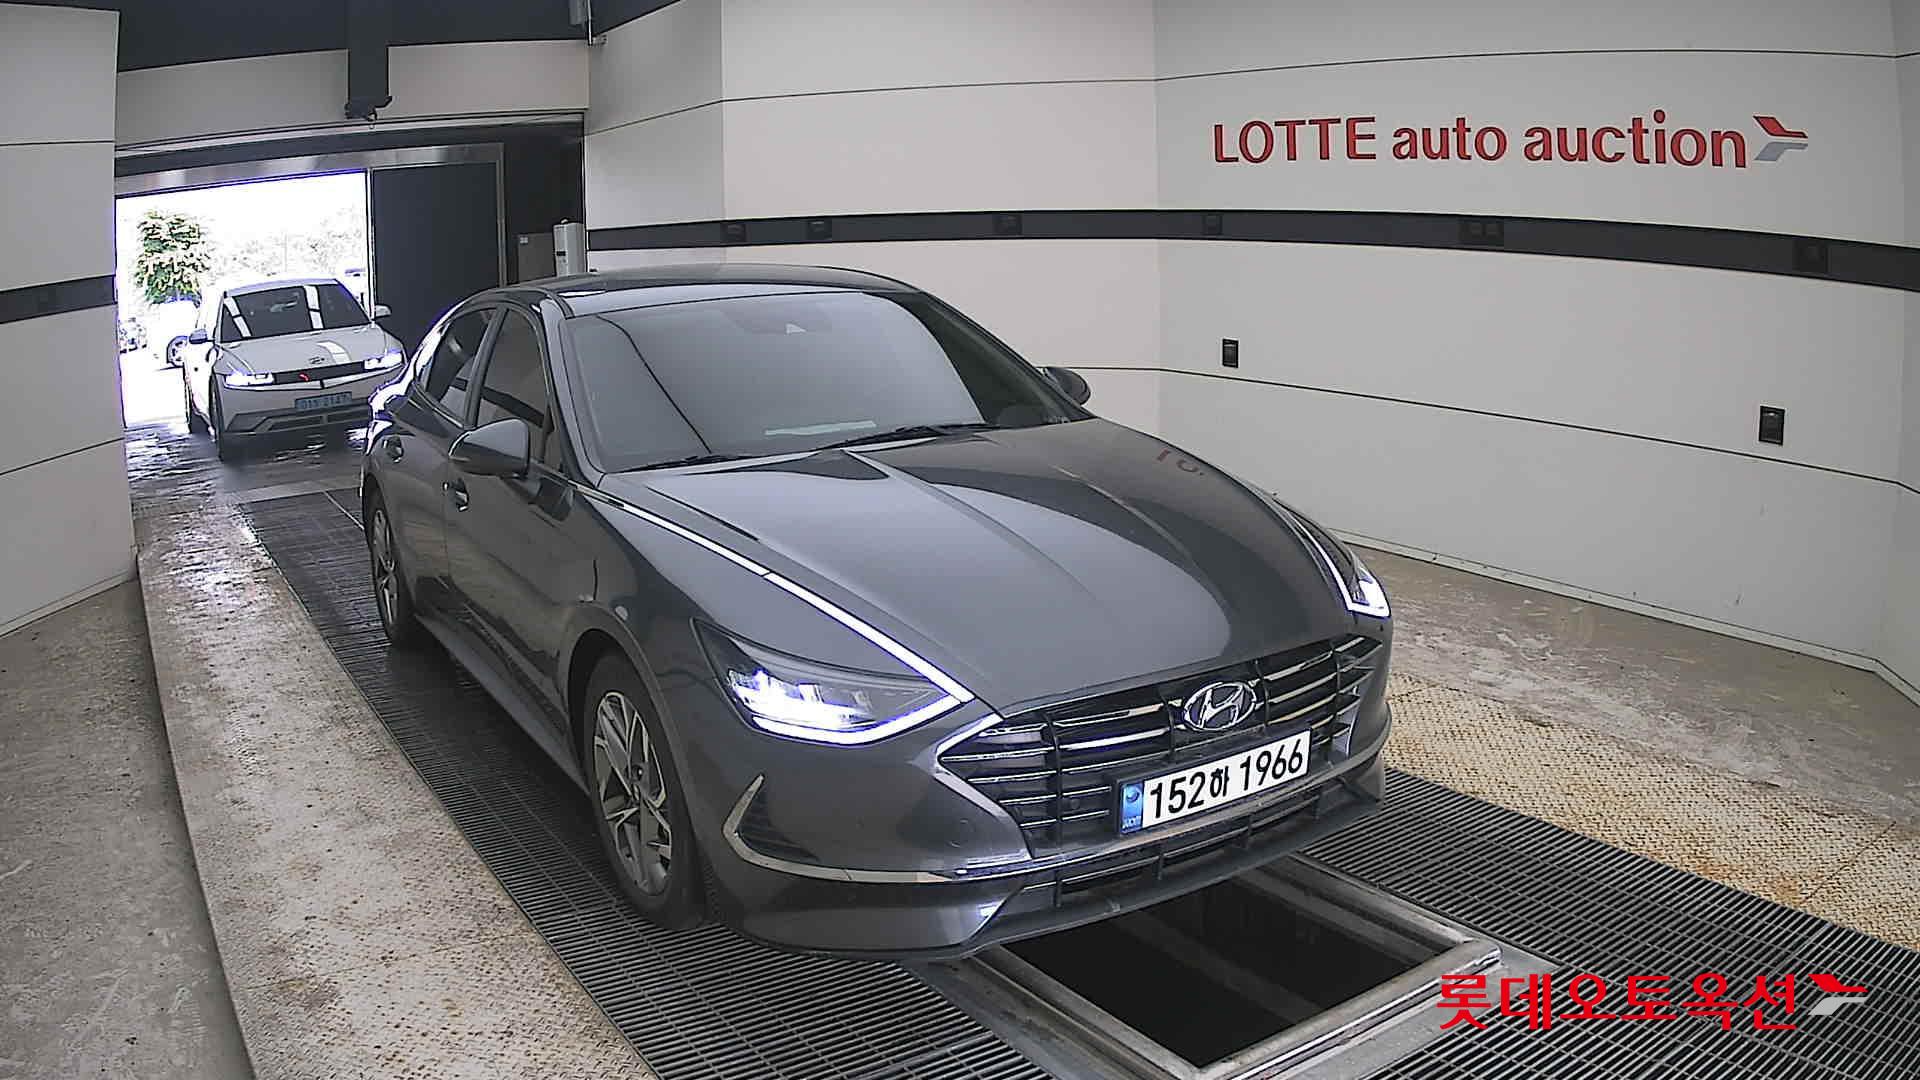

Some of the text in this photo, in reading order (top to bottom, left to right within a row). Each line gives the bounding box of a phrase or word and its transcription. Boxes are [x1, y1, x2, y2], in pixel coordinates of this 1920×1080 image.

[1213, 109, 1748, 169] LOTTE auto auction
[1150, 738, 1304, 819] 152하 1966
